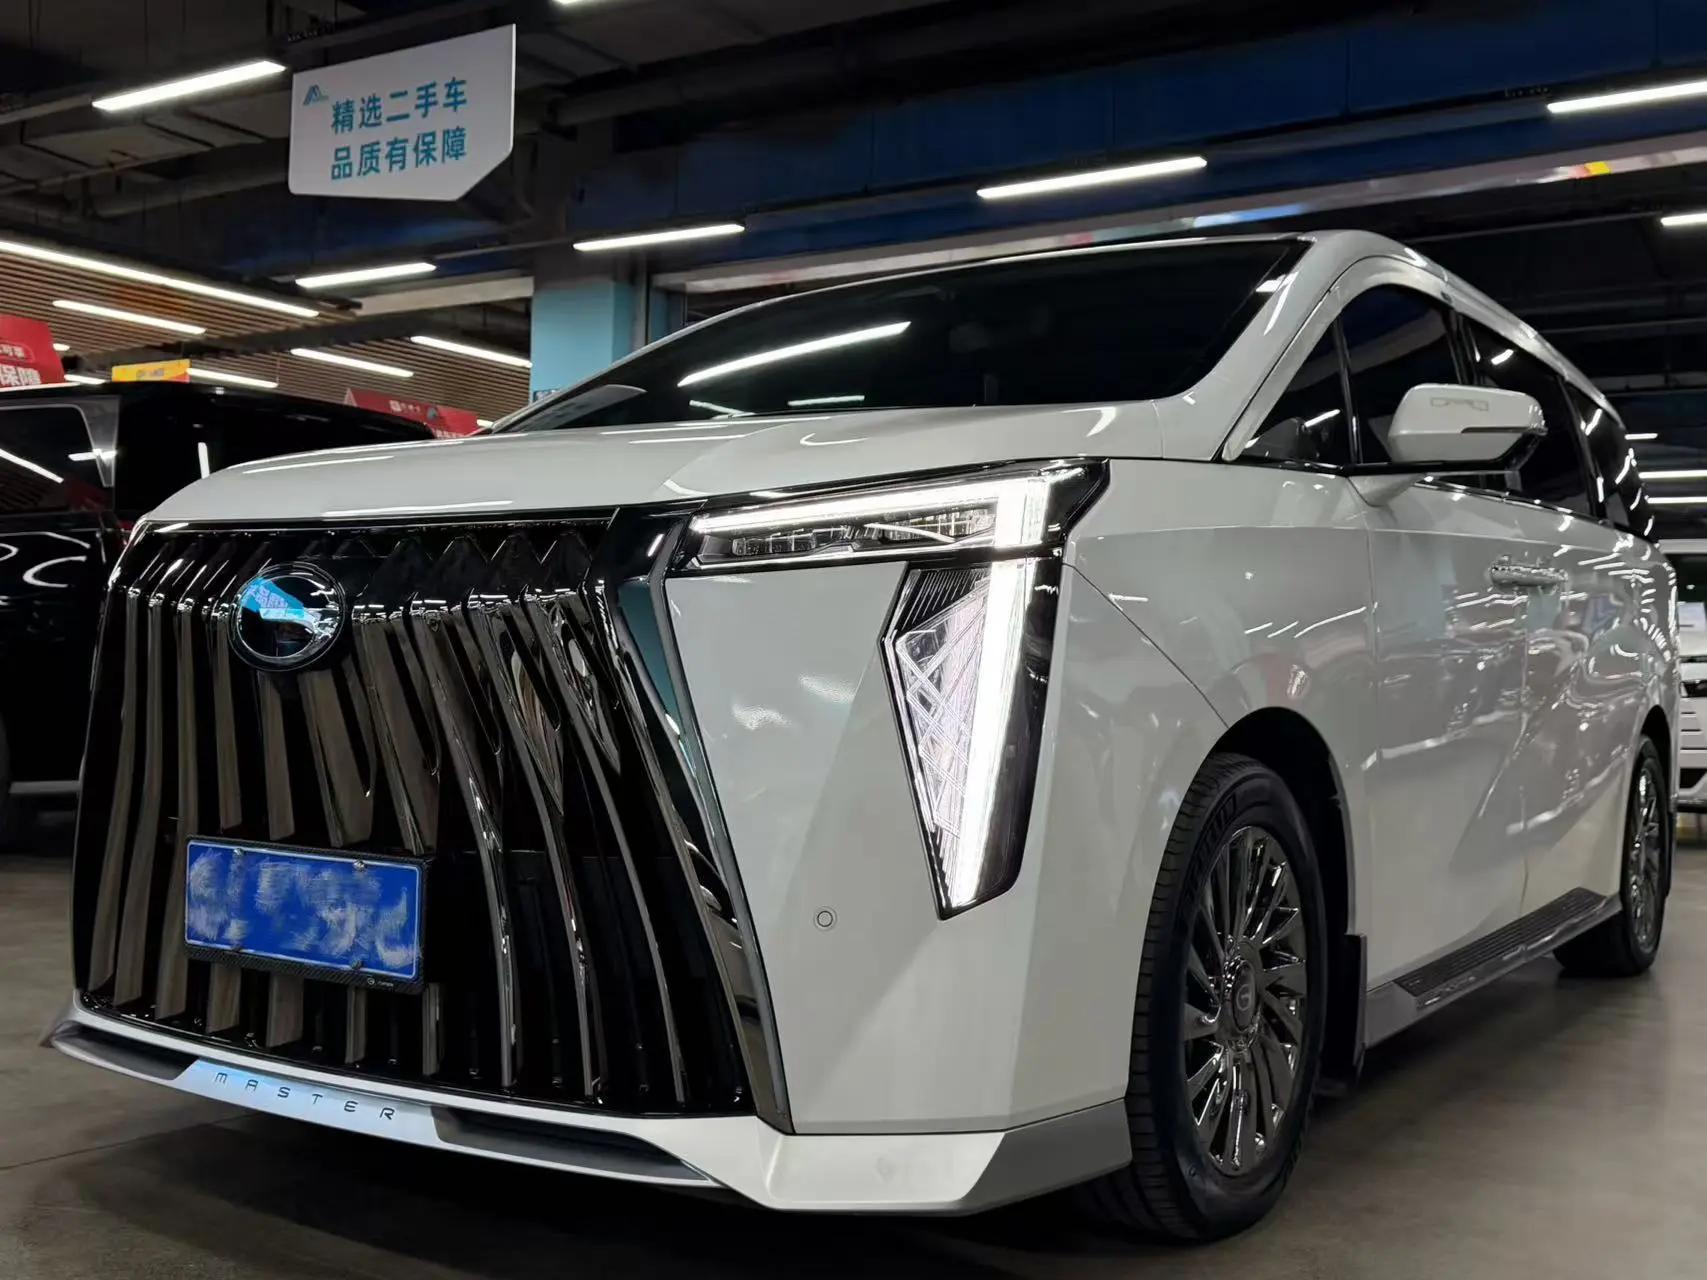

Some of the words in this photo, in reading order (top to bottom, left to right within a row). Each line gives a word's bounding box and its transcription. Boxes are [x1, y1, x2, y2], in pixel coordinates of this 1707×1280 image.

[331, 76, 467, 135] 精选二手车
[331, 126, 467, 180] 品质有保障
[214, 1072, 396, 1120] MASTER
